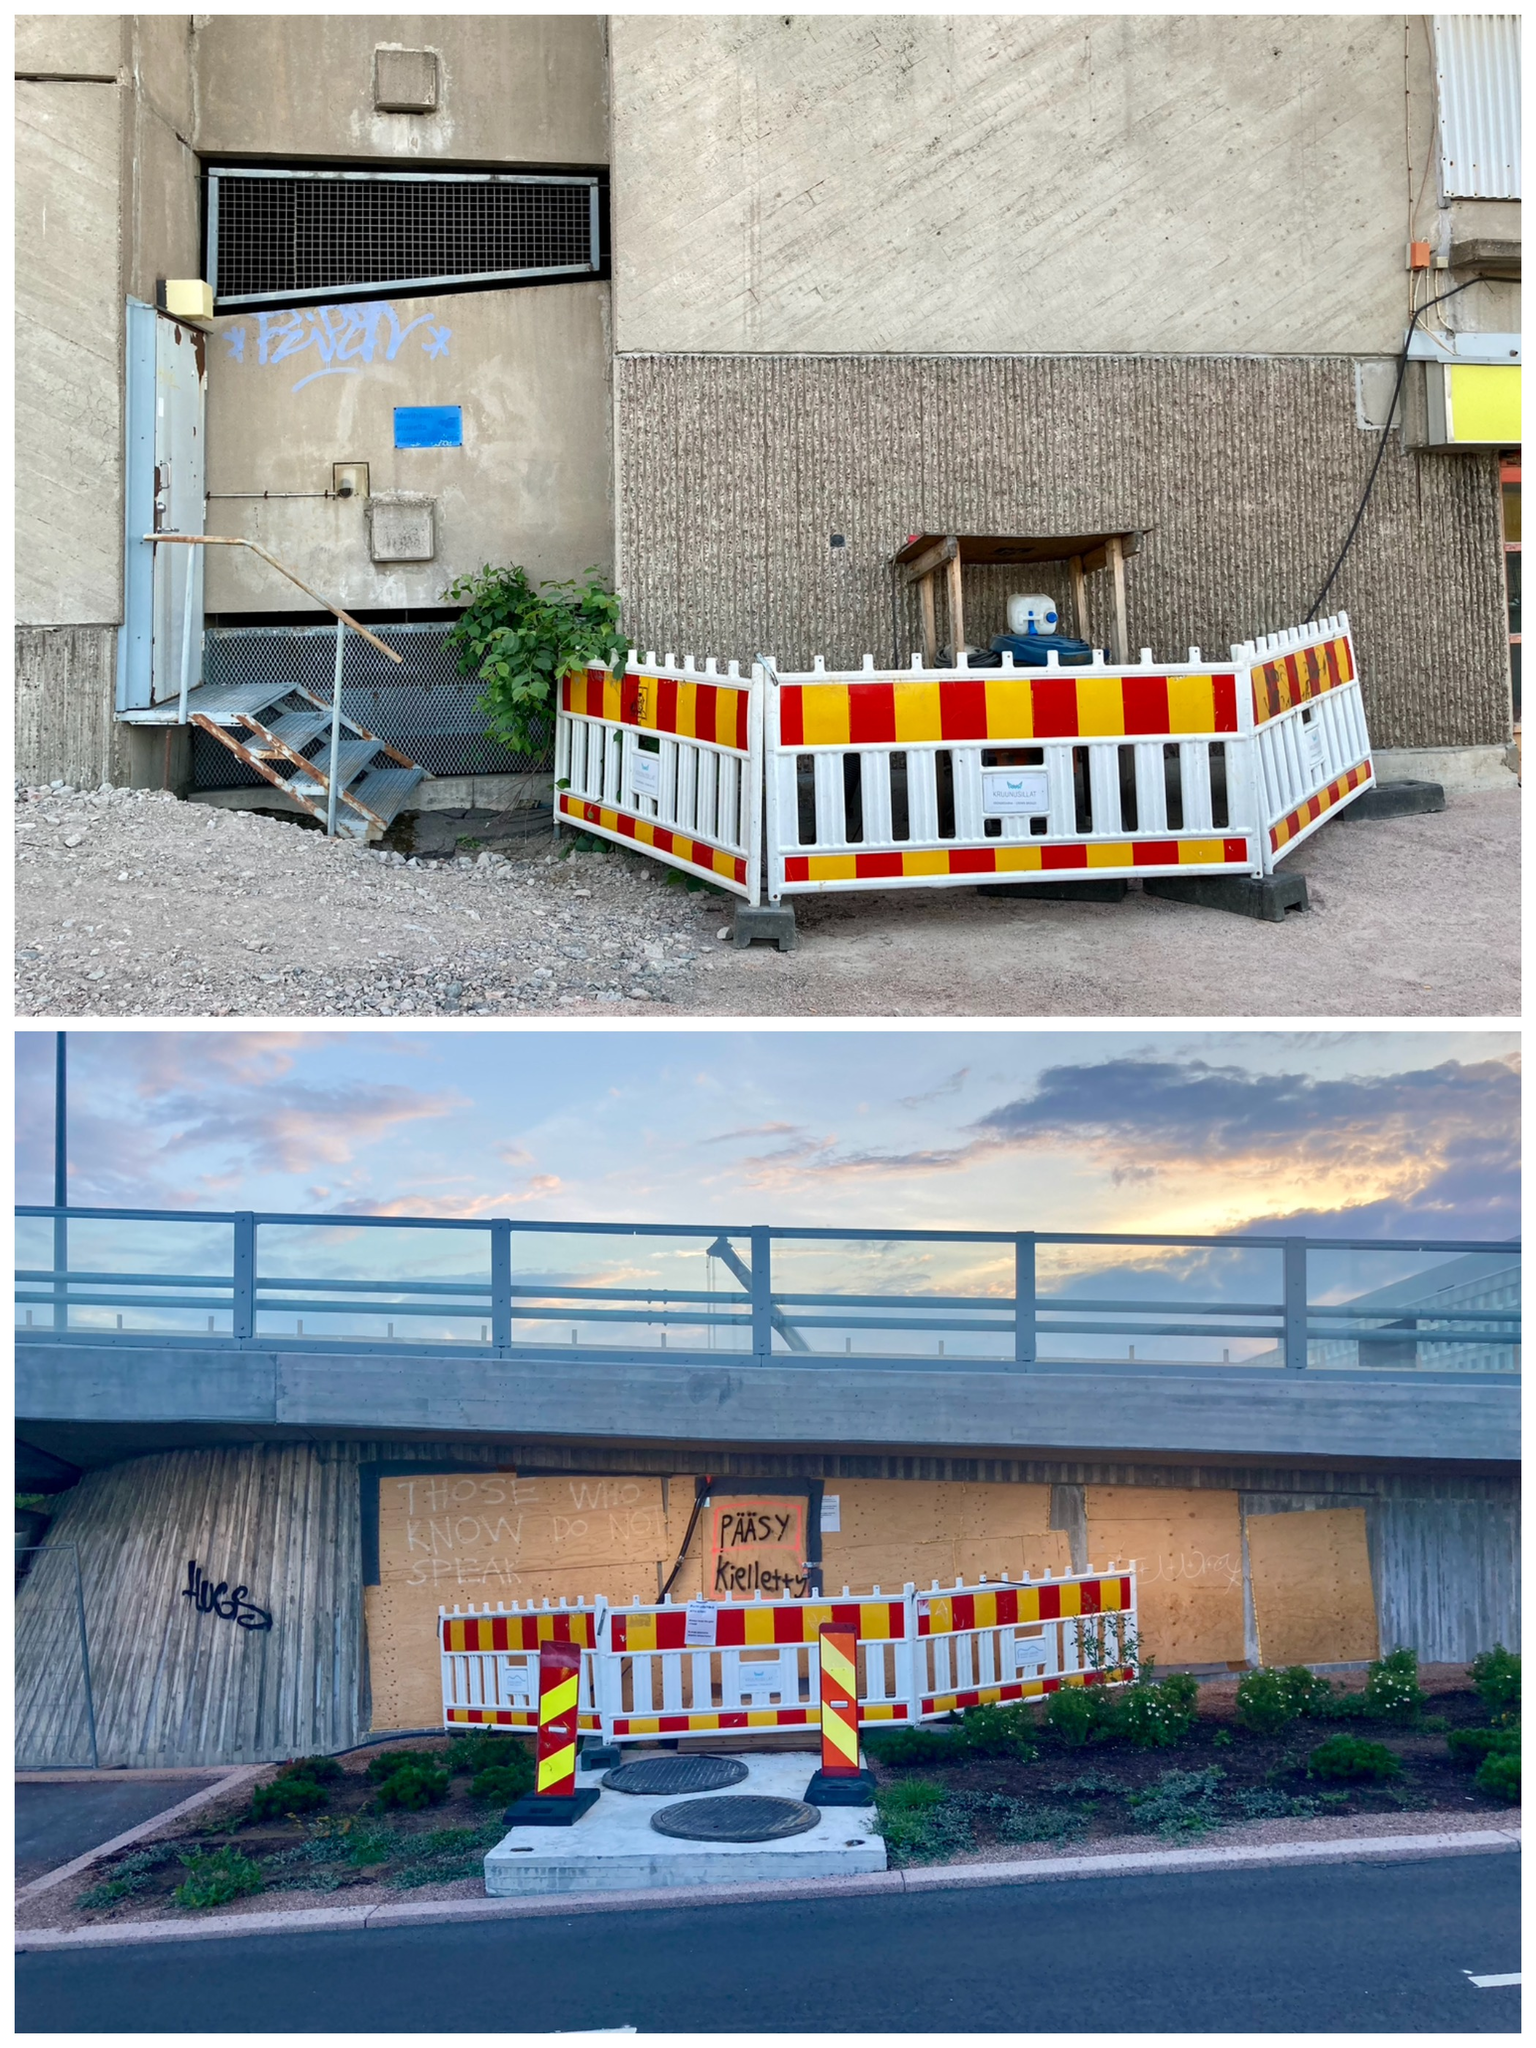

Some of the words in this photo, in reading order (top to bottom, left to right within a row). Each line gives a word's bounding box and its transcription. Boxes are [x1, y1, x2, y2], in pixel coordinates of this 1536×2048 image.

[397, 1477, 539, 1515] THOSE
[569, 1482, 641, 1509] WHO
[406, 1515, 524, 1555] KNOW
[609, 1506, 663, 1540] NOT
[720, 1511, 790, 1553] PÄÄSY
[406, 1557, 523, 1587] SPEAK
[715, 1555, 809, 1599] Kielletty
